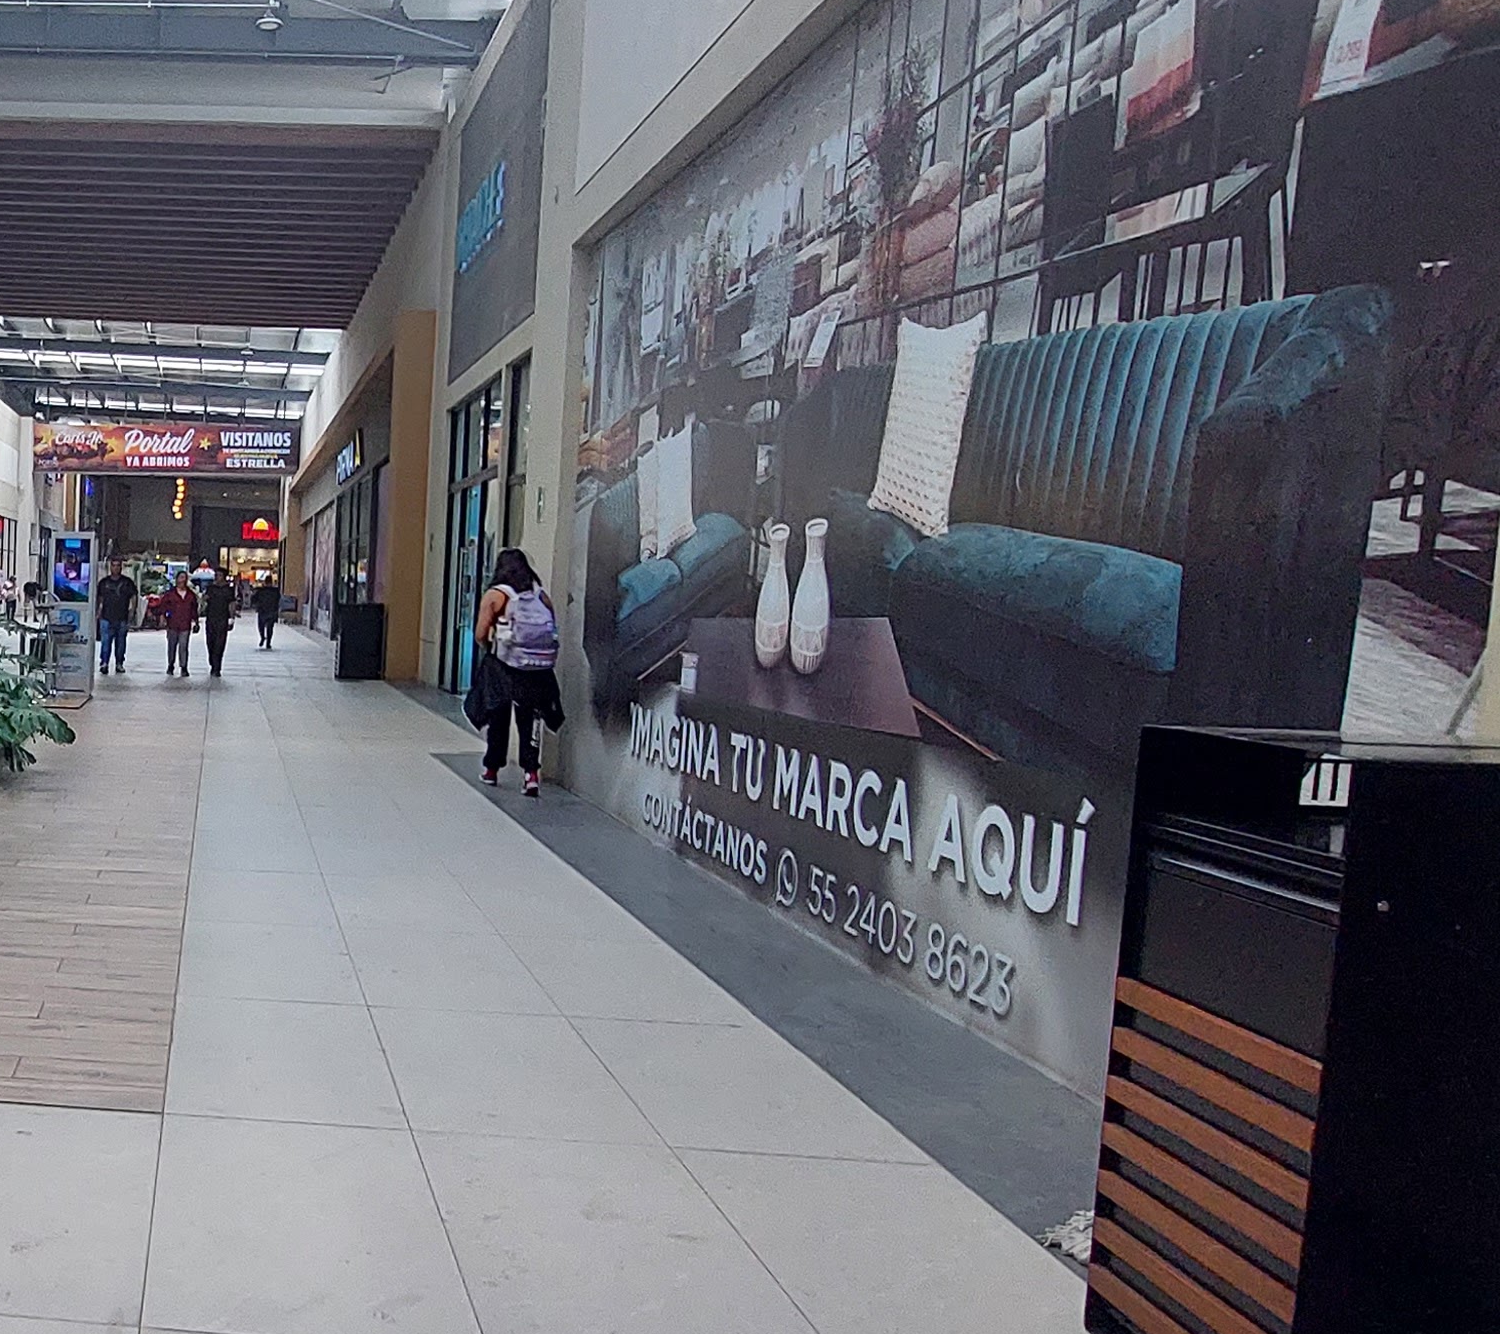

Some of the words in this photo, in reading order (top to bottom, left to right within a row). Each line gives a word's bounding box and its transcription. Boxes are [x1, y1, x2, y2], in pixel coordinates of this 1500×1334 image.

[124, 428, 195, 454] Portal
[220, 431, 292, 447] VISITANOS
[125, 456, 141, 467] YA
[142, 456, 190, 467] ABRIMOS
[226, 458, 286, 469] ESTRELLA
[629, 701, 721, 786] IMAGINA
[730, 733, 767, 802] TU
[772, 746, 913, 863] MARCA
[927, 794, 1097, 927] AQUÍ
[641, 792, 768, 886] CONTÁCTANOS
[807, 865, 837, 925] 55
[842, 883, 916, 966] 2403
[924, 923, 1016, 1018] 8623
